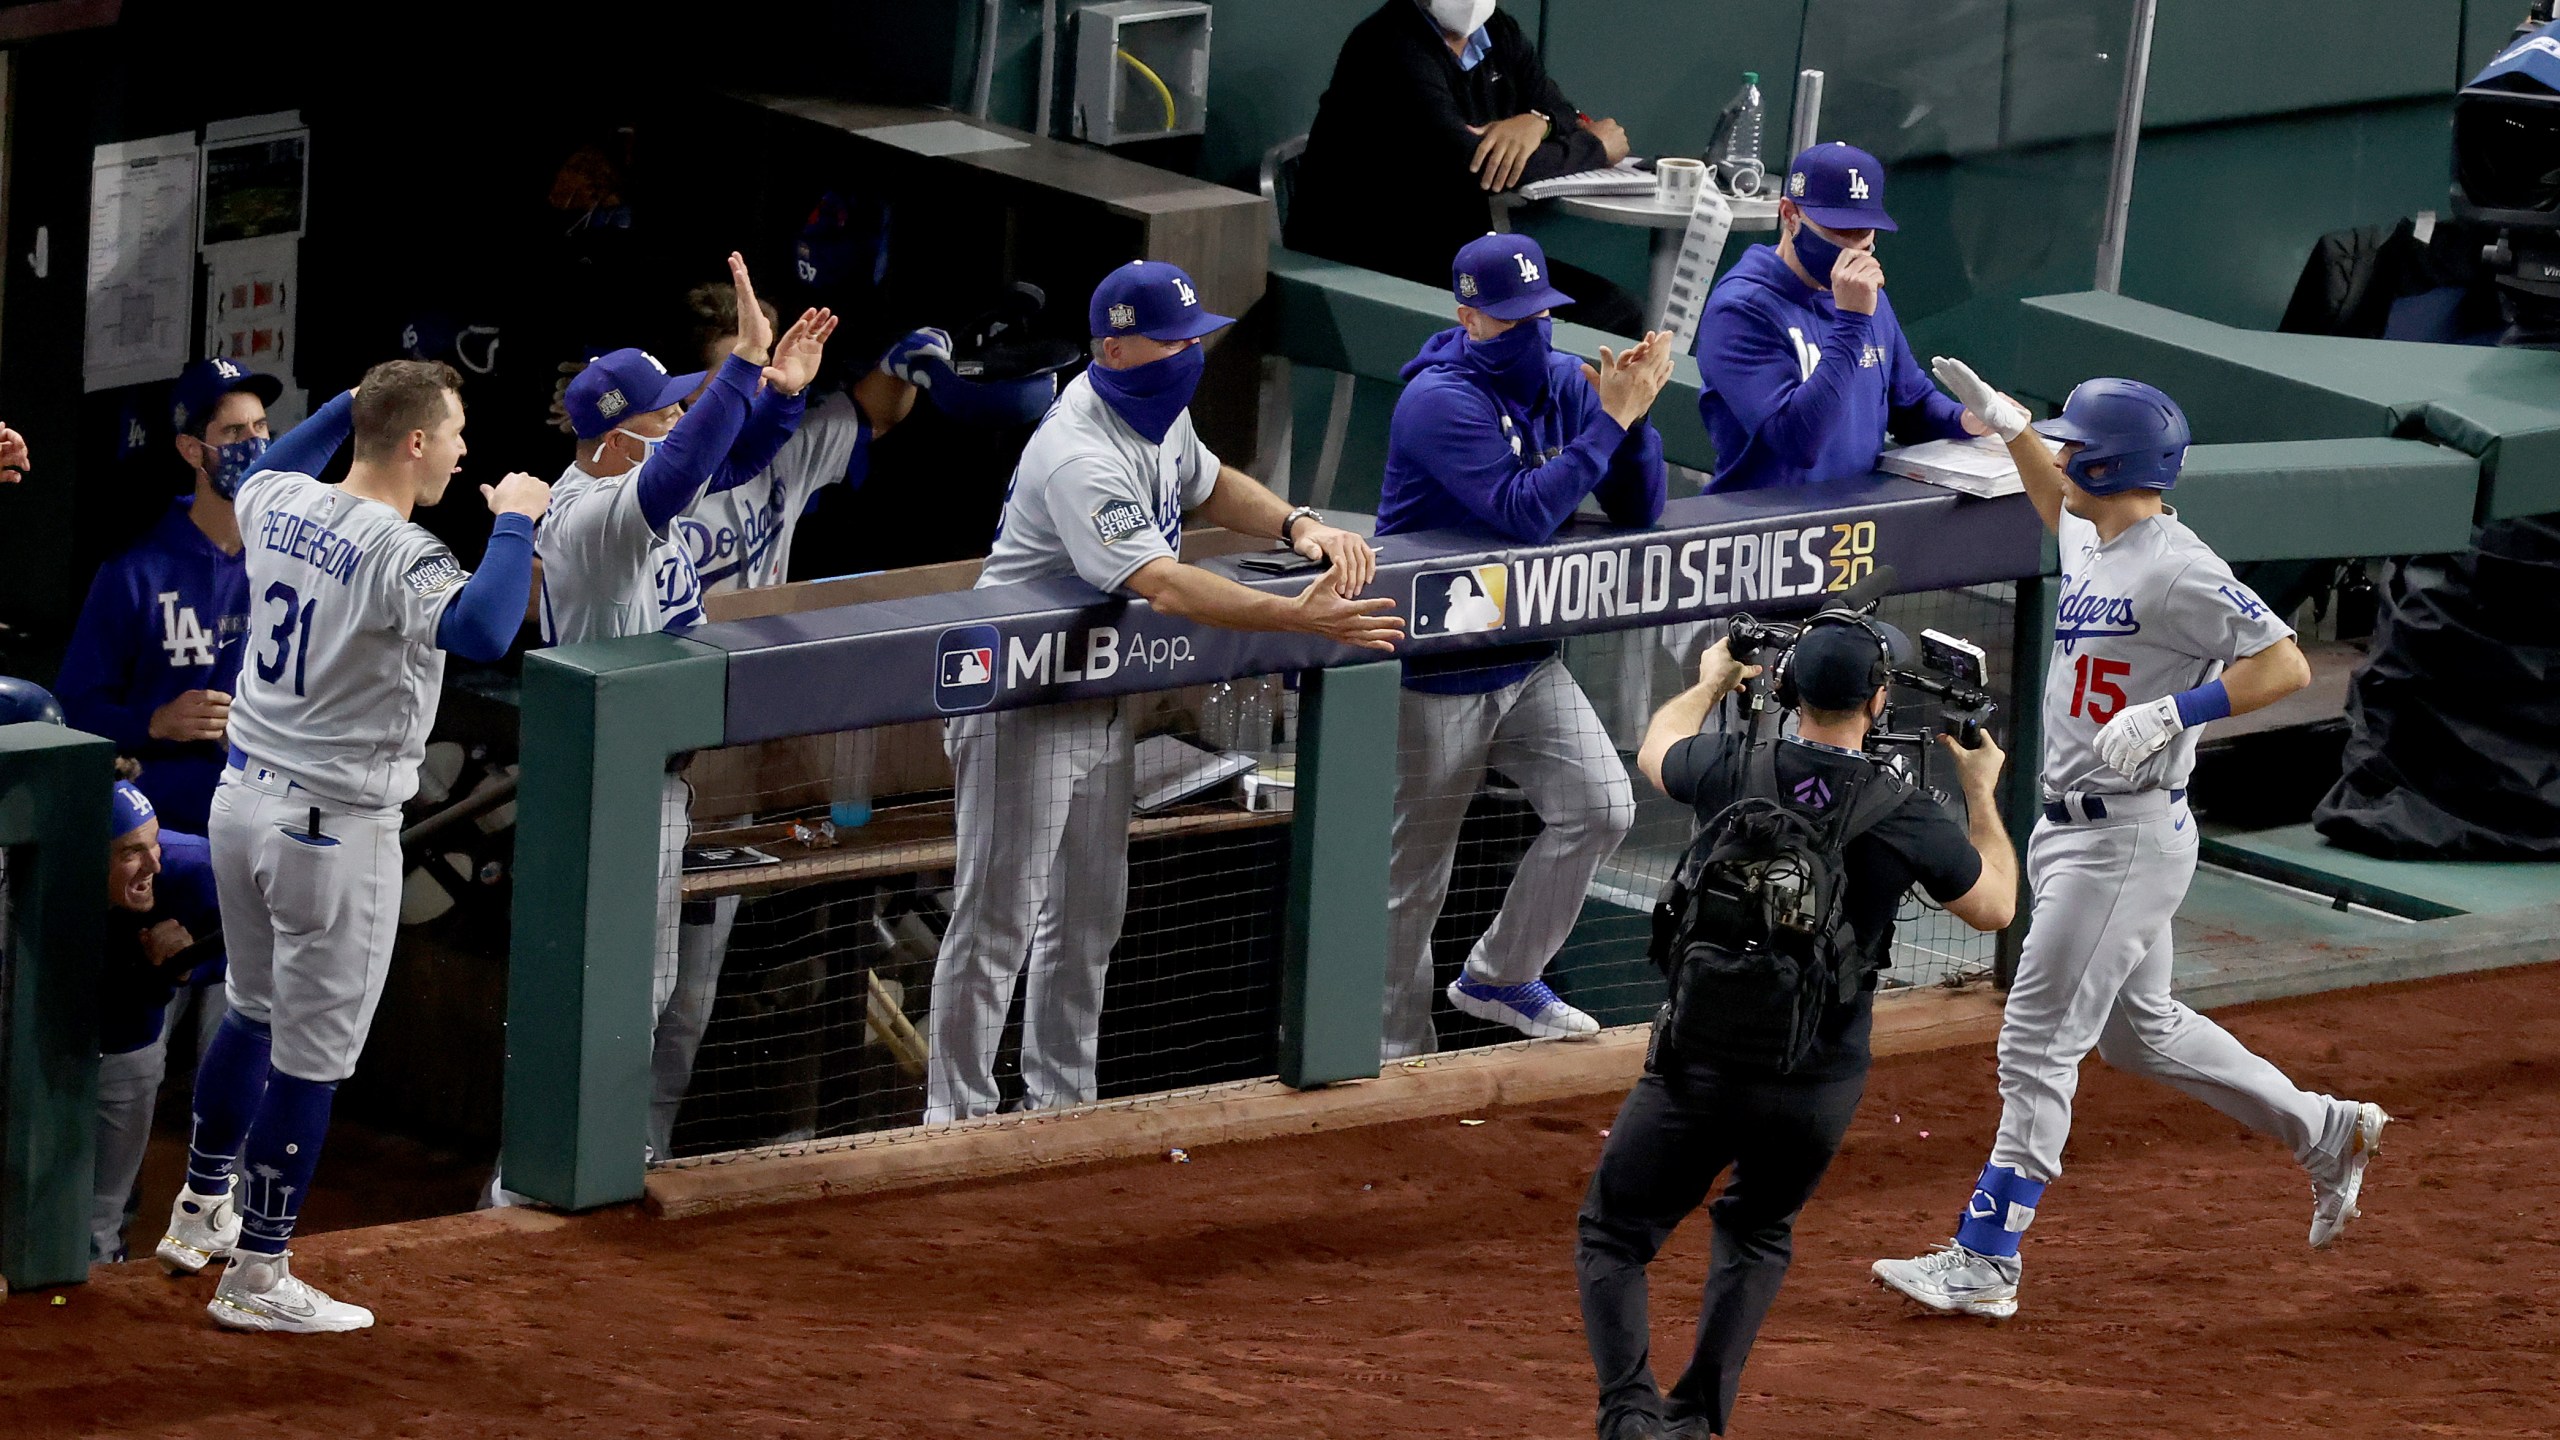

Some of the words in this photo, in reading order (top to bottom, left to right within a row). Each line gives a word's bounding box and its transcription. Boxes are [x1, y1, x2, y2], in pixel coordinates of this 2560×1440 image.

[1848, 169, 1869, 199] LA
[1513, 253, 1541, 283] LA
[1171, 278, 1197, 307] LA
[211, 357, 241, 379] LA
[1095, 504, 1141, 527] WORLD
[1100, 514, 1147, 539] SERIES
[257, 509, 363, 586] PEDERSON
[1829, 521, 1876, 557] 20
[406, 557, 451, 584] WORLD
[413, 565, 458, 593] SERIES
[1514, 545, 1671, 628] WORLD
[2218, 585, 2269, 620] LA
[158, 591, 215, 667] LA
[256, 580, 317, 697] 31
[1006, 626, 1120, 690] MLB
[2069, 653, 2131, 725] 15
[117, 786, 154, 816] LA
